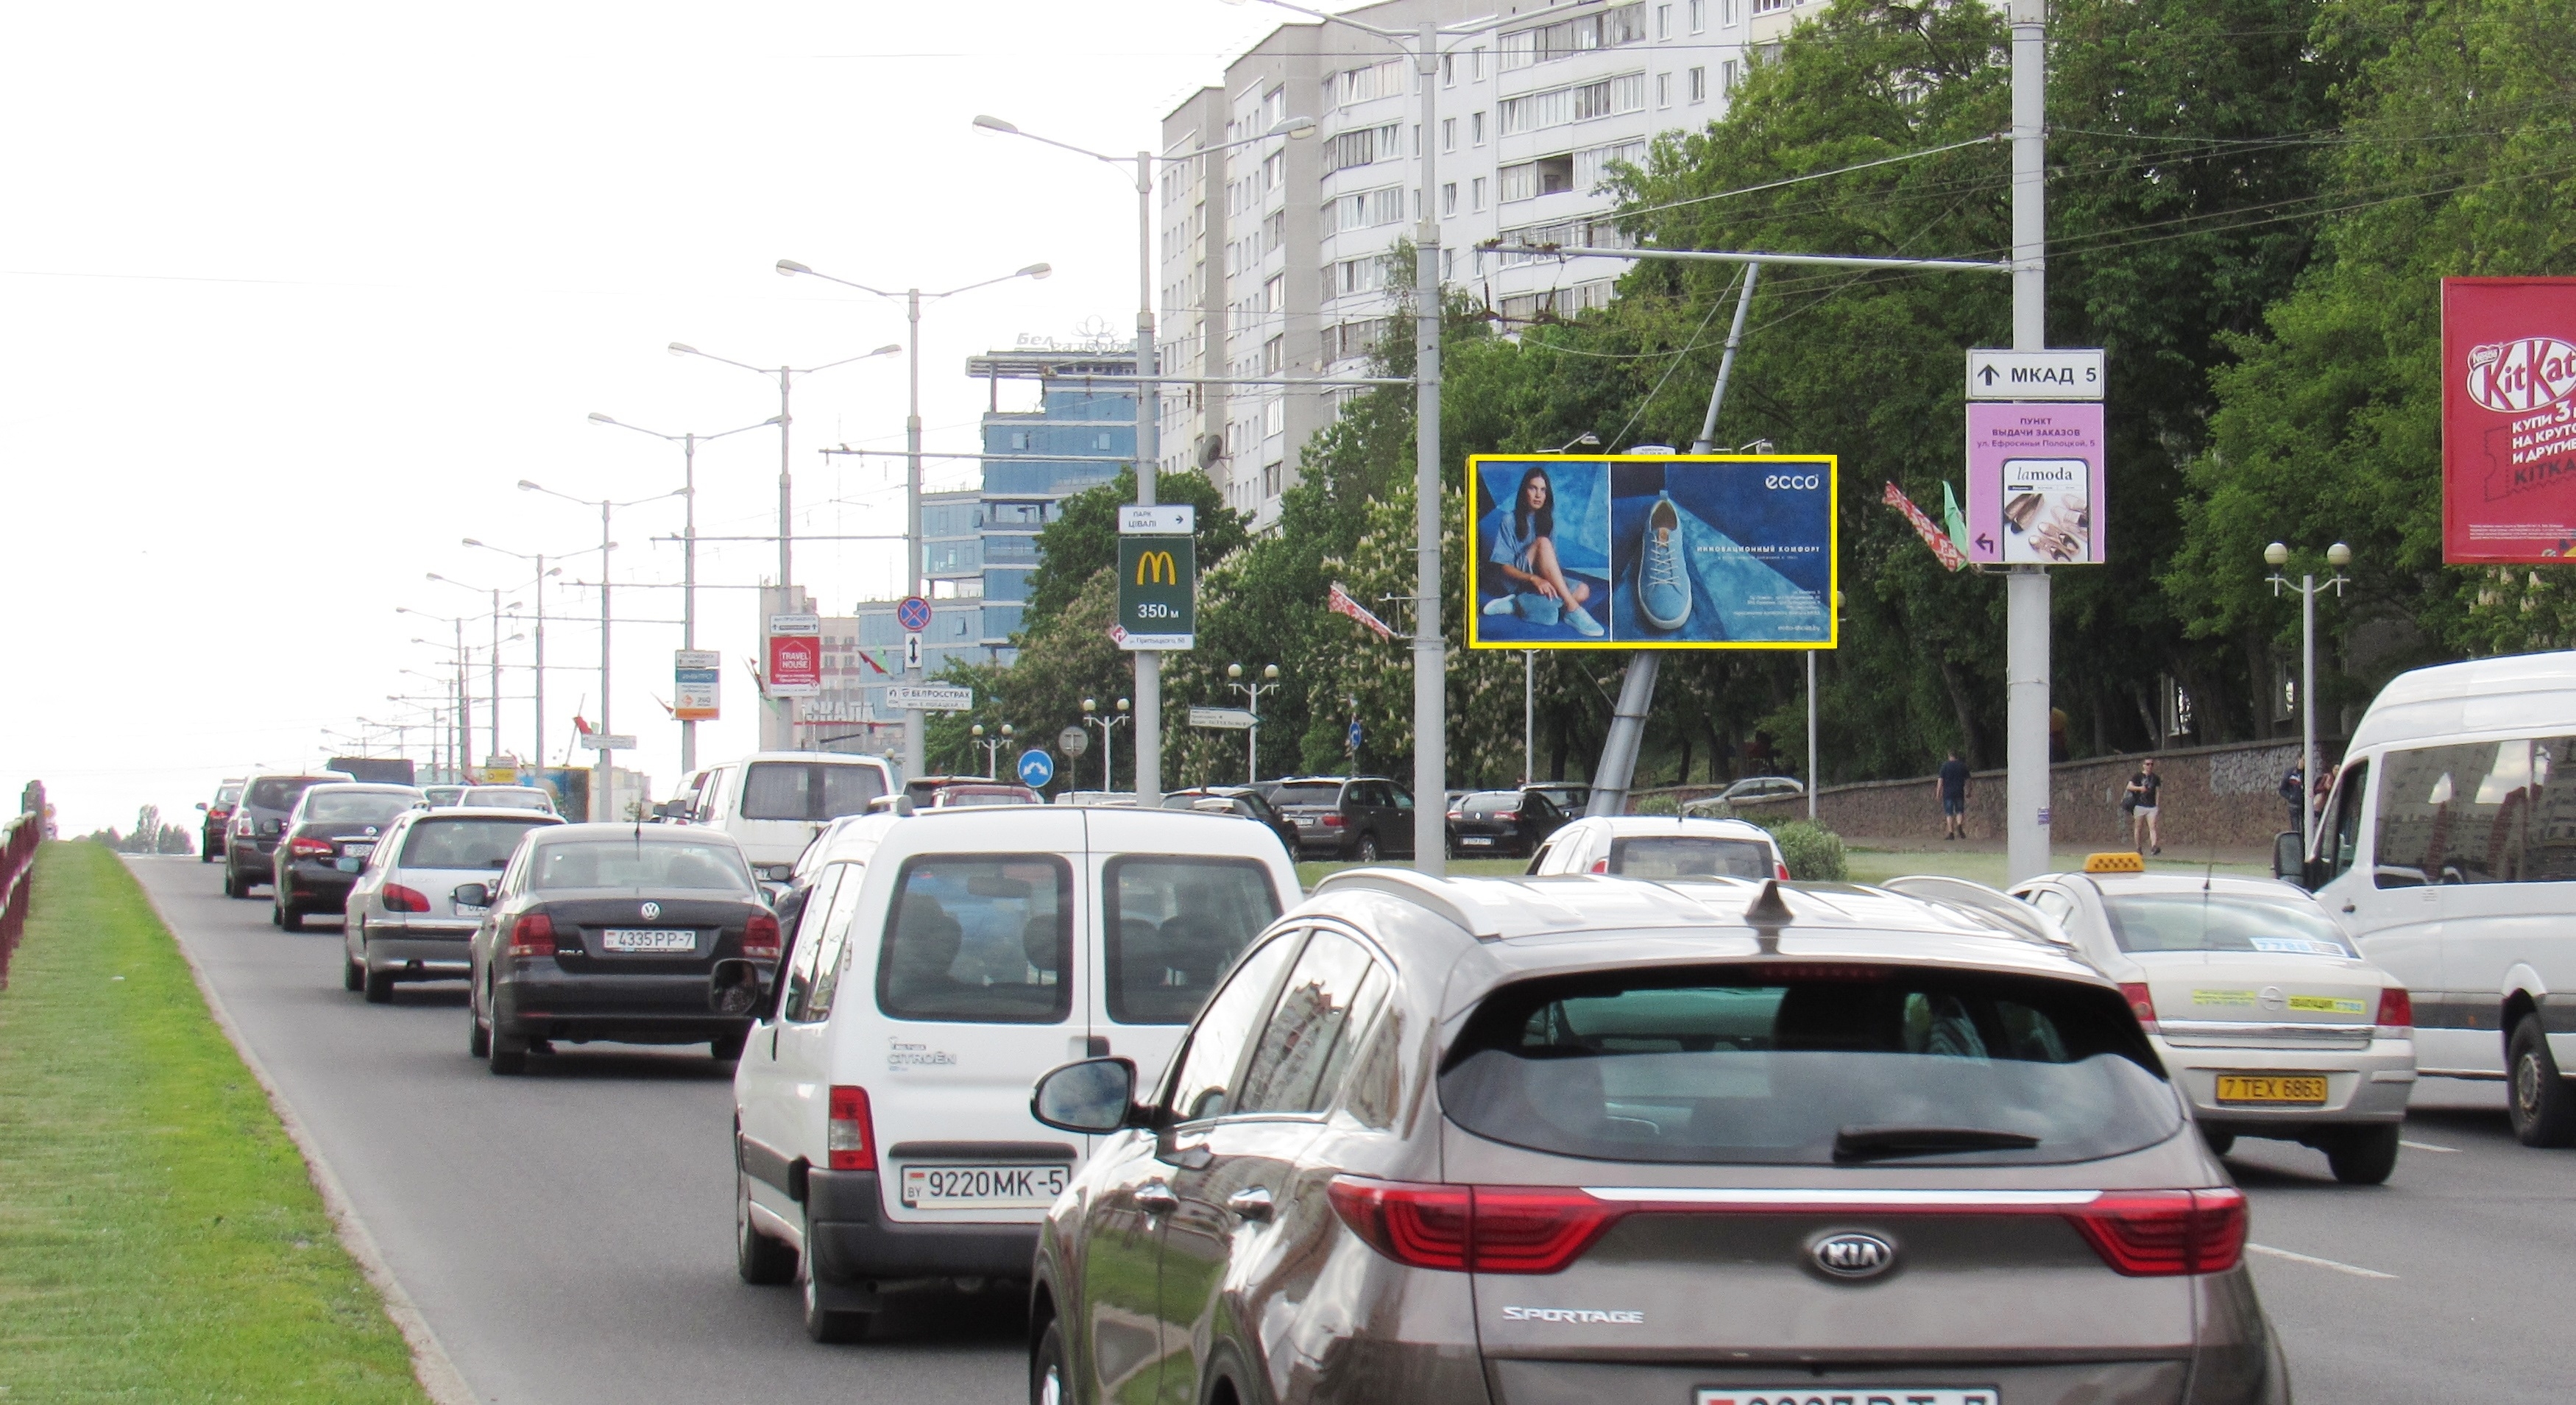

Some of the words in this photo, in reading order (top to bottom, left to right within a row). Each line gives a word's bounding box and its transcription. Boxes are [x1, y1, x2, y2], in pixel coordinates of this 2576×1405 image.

[2011, 367, 2074, 385] МКАД
[2086, 367, 2096, 382] 5
[2483, 340, 2576, 409] KitKat
[2020, 417, 2052, 425] ПУНКТ
[2512, 414, 2552, 433] КУПИ
[2554, 400, 2571, 422] 3
[1992, 429, 2034, 437] ВЫДАЧИ
[2036, 428, 2081, 436] ЗАКАЗОВ
[1992, 439, 2040, 448] Ефросиньи
[2512, 434, 2533, 450] НА
[2512, 451, 2523, 464] И
[2017, 467, 2073, 481] lamoda
[1765, 475, 1819, 490] ecco
[1696, 545, 1775, 553] ИННОВАЦИОННЫЙ
[1138, 604, 1167, 618] 350
[782, 651, 808, 660] TRAVEL
[888, 1051, 957, 1065] CITROËN
[2226, 1079, 2235, 1097] 7
[2240, 1079, 2277, 1097] TEX
[907, 1186, 921, 1197] BY
[1825, 1242, 1881, 1267] KIA
[1502, 1305, 1644, 1324] SPORTAGE
